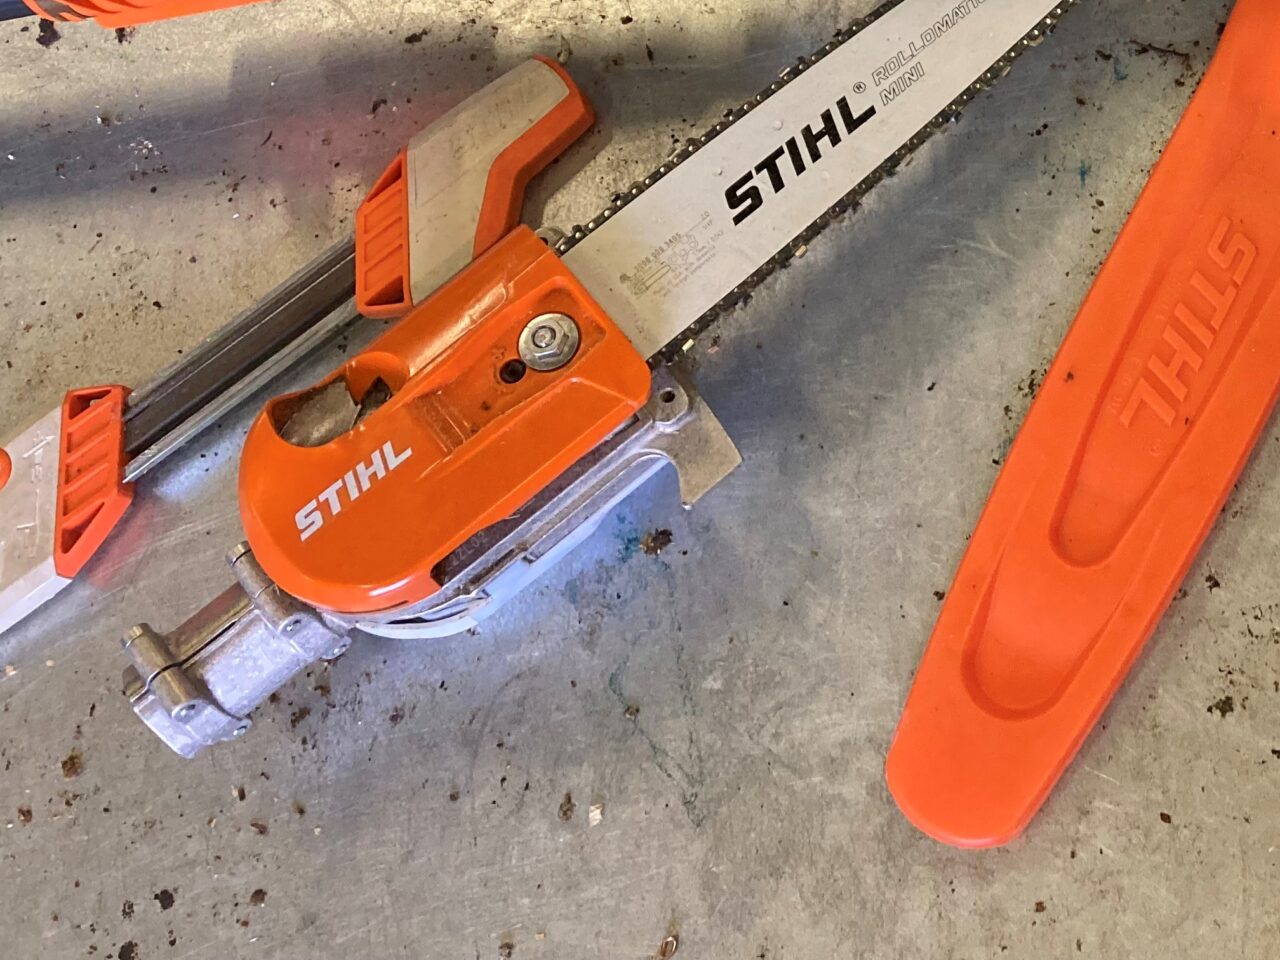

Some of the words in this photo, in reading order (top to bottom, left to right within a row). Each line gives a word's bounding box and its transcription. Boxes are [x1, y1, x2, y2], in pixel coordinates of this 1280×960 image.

[880, 61, 925, 107] MINI
[725, 96, 877, 226] STIHL
[1119, 215, 1257, 429] STIHL
[295, 440, 412, 542] STIHL
